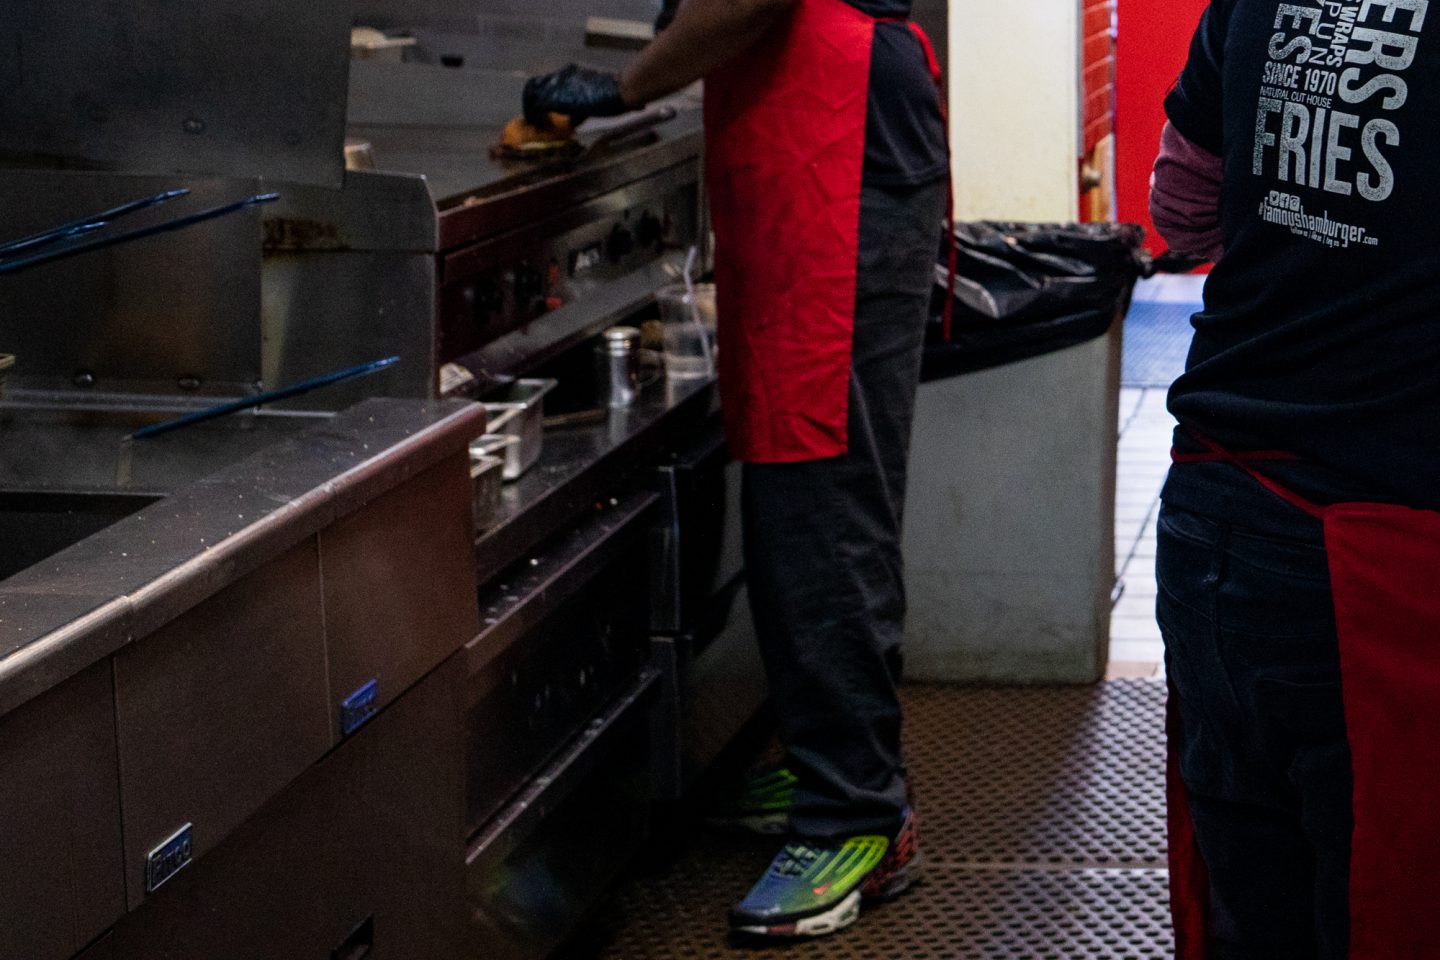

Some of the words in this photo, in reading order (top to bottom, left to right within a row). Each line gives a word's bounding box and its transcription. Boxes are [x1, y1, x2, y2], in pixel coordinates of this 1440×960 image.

[1326, 6, 1359, 68] WRAPS
[1260, 85, 1290, 101] NATURAL
[1290, 90, 1307, 103] CUT
[1306, 94, 1333, 109] HOUSE
[1262, 60, 1302, 89] SINCE
[1303, 67, 1337, 96] 1970
[1252, 96, 1400, 202] FRIES
[1263, 196, 1379, 248] famoushamburger.com
